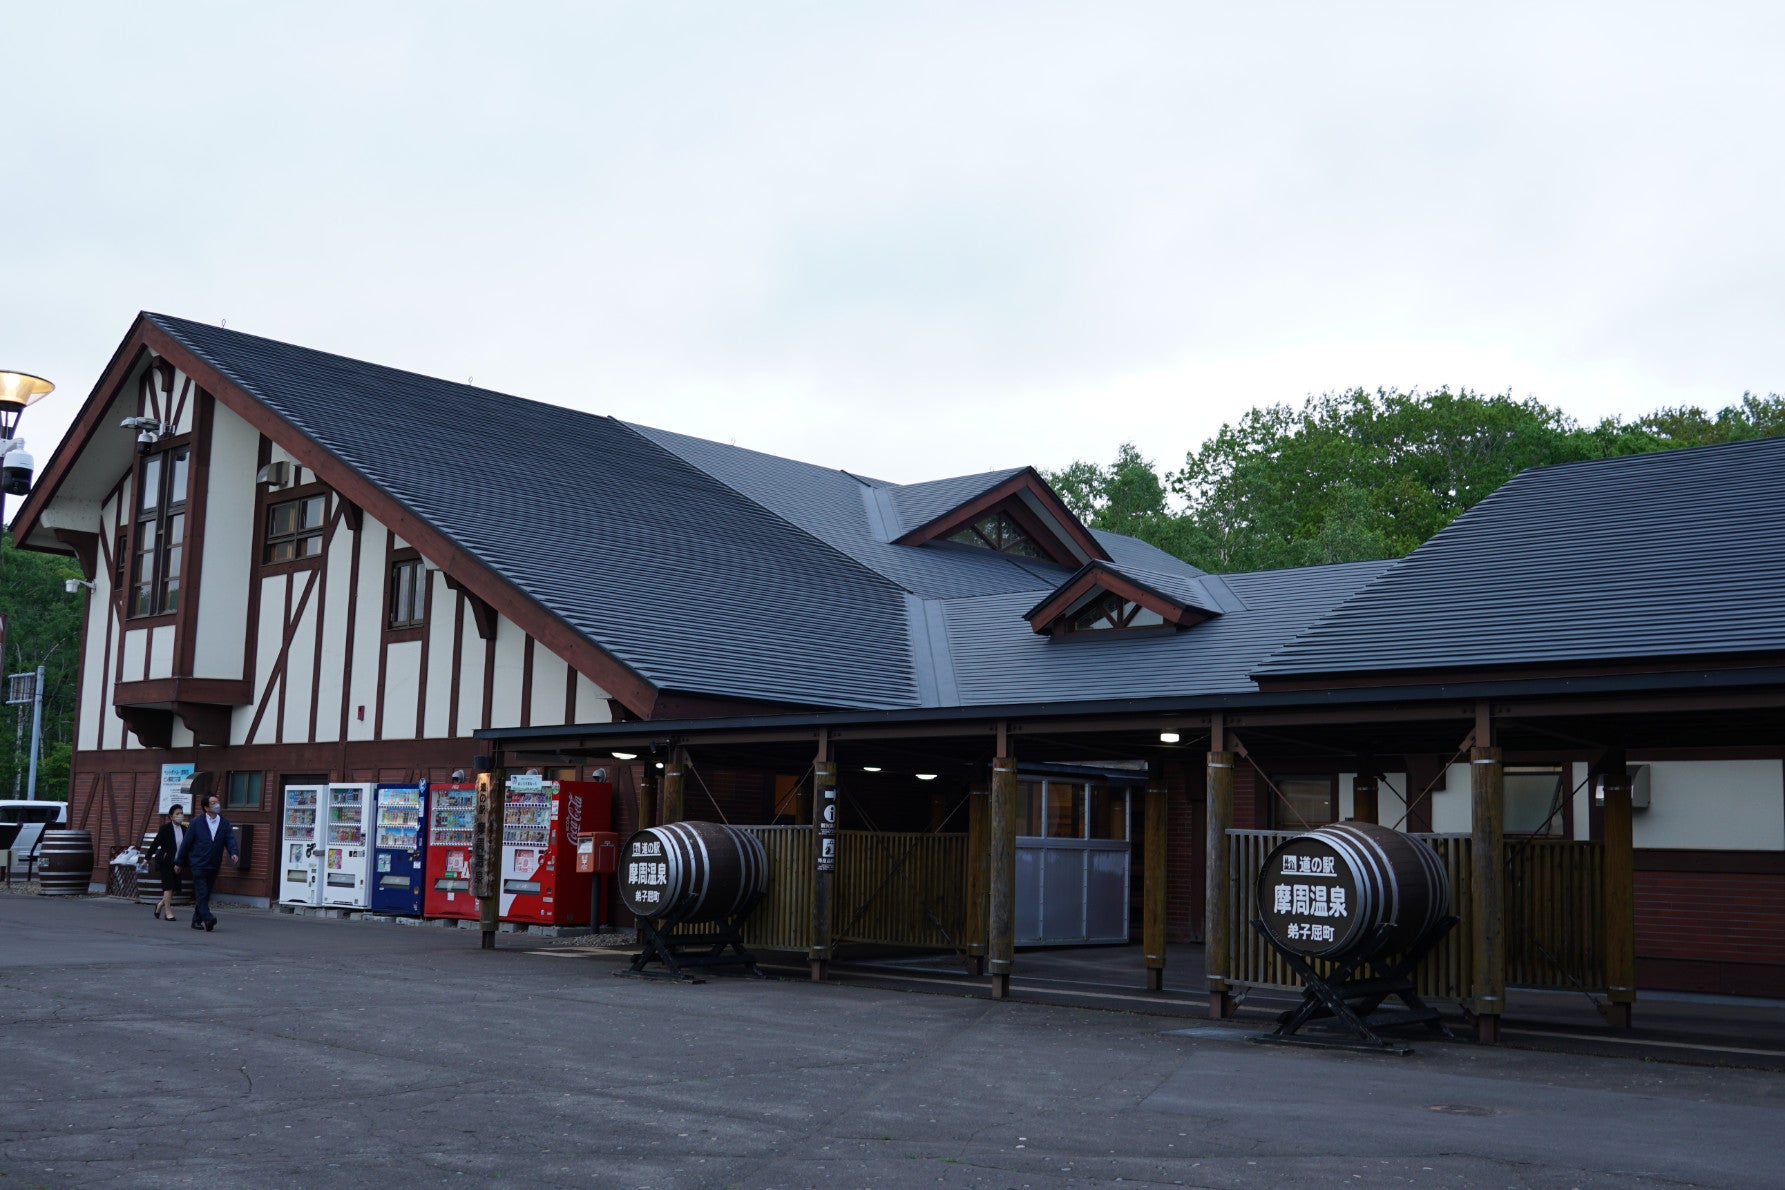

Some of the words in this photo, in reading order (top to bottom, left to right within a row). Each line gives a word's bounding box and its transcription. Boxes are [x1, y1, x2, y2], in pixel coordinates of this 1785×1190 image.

[641, 841, 661, 855] 道の駅
[628, 862, 667, 885] 摩周温泉
[1299, 856, 1335, 874] 道の駅
[635, 890, 660, 903] 弟子屈町
[1273, 883, 1348, 918] 摩周温泉
[1287, 922, 1335, 942] 弟子屈町
